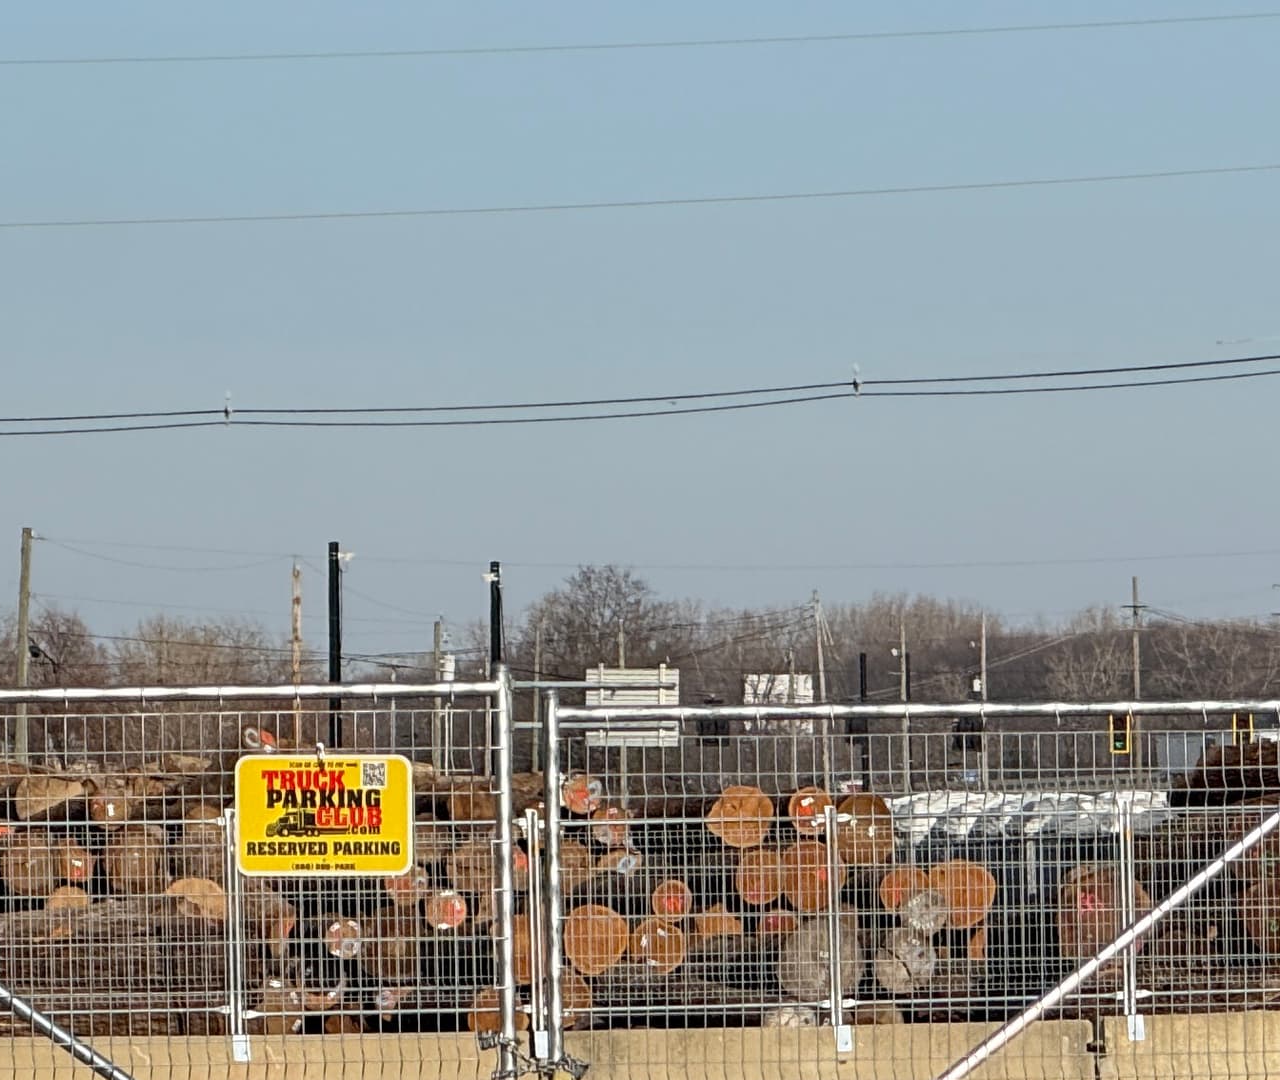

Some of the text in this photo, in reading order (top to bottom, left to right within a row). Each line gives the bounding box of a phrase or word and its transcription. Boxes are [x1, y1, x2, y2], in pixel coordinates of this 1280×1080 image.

[261, 770, 346, 790] TRUCK
[266, 789, 381, 809] PARKING
[316, 807, 383, 827] CLUB
[347, 826, 381, 835] .com
[247, 841, 401, 856] RESERVED PARKING
